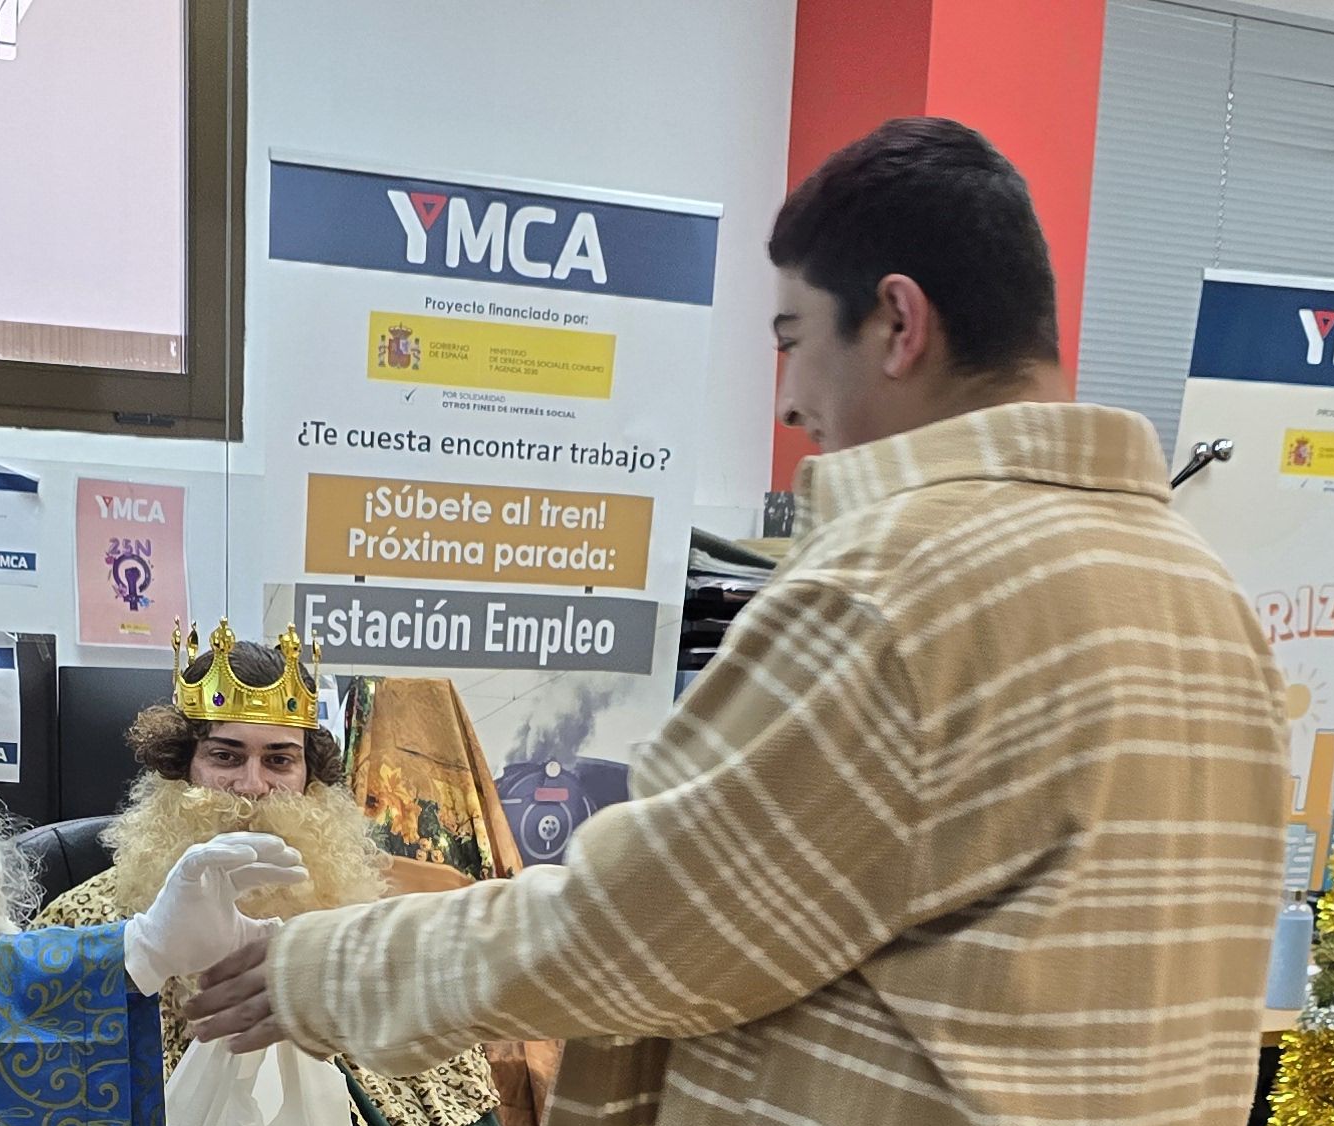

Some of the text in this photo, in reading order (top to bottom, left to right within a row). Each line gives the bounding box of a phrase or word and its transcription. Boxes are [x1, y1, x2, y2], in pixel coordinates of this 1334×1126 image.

[387, 190, 608, 285] YMCA
[424, 296, 589, 326] Proyecto financiado por:
[429, 341, 470, 352] GOBIERNO
[429, 350, 469, 361] DE ESPAÑA
[442, 390, 458, 399] POR
[442, 401, 576, 419] OTROS FINES DE INTERÉS SOCIAL
[298, 420, 672, 474] ¿Te cuesta encontrar trabajo?
[95, 494, 166, 525] YMCA
[365, 484, 607, 530] ¡Súbete al tren!
[109, 537, 152, 558] 25N
[348, 526, 617, 572] Próxima parada:
[304, 594, 616, 667] Estación Empleo
